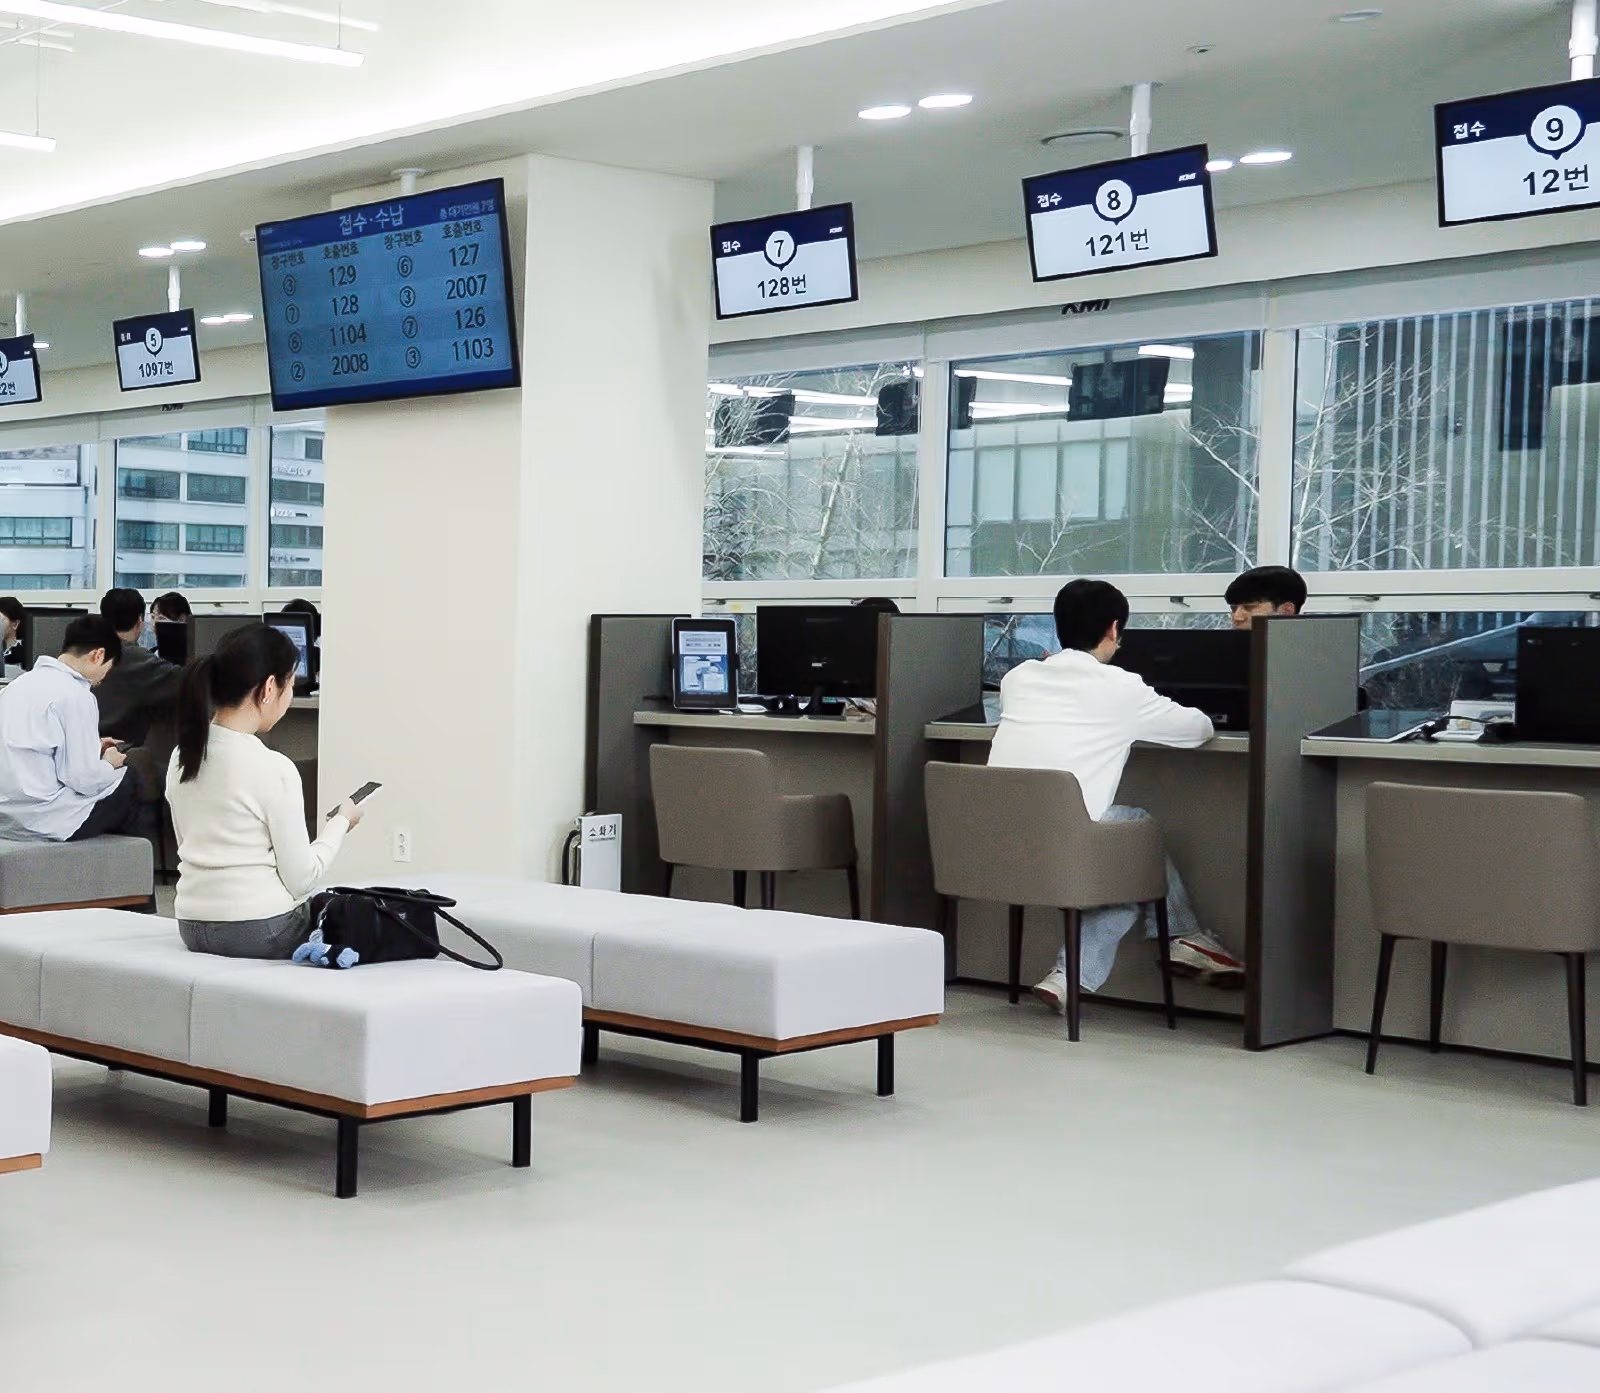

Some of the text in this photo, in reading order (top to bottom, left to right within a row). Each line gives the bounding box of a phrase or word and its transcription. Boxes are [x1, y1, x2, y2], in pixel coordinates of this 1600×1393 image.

[1453, 121, 1487, 140] 접수
[1545, 117, 1564, 142] 9
[1522, 164, 1590, 196] 12번
[1036, 193, 1062, 208] 접수
[1106, 189, 1121, 211] 8
[384, 229, 424, 250] 창구번호
[442, 220, 485, 239] 호출번호
[323, 241, 360, 260] 호출번호
[722, 240, 741, 253] 접수
[773, 239, 785, 258] 7
[1085, 228, 1150, 257] 121번
[271, 250, 305, 270] 창구번호
[449, 243, 480, 267] 127
[329, 265, 357, 287] 129
[446, 274, 487, 300] 2007
[757, 273, 807, 299] 128번
[331, 294, 359, 316] 128
[455, 306, 486, 330] 126
[150, 333, 157, 347] 5
[329, 323, 366, 346] 1104
[452, 337, 494, 361] 1103
[138, 360, 174, 378] 1097번
[331, 353, 369, 376] 2008
[589, 823, 617, 837] 소화기
